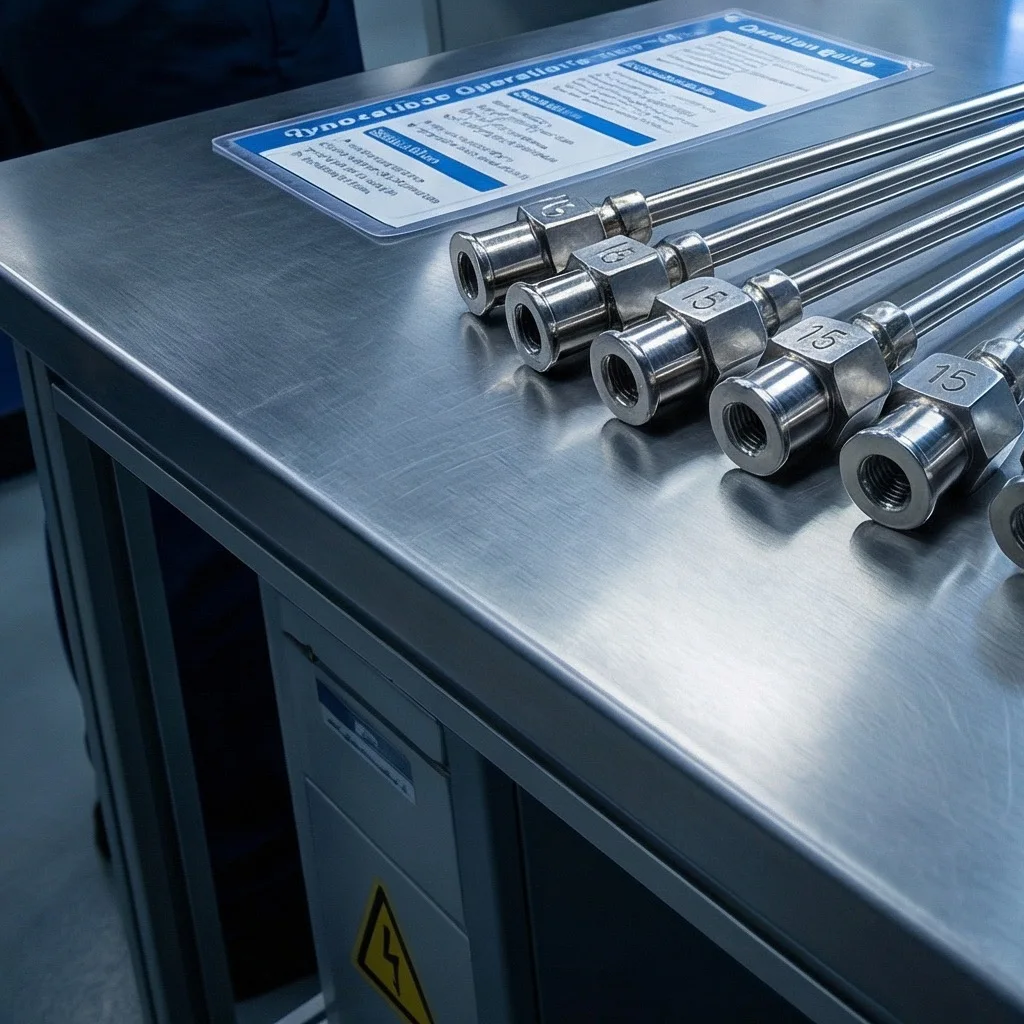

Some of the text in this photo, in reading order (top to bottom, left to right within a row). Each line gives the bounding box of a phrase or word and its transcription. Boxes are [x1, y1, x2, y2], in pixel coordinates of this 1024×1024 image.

[682, 284, 729, 310] 15
[795, 324, 848, 351] 15
[926, 363, 978, 393] 15
